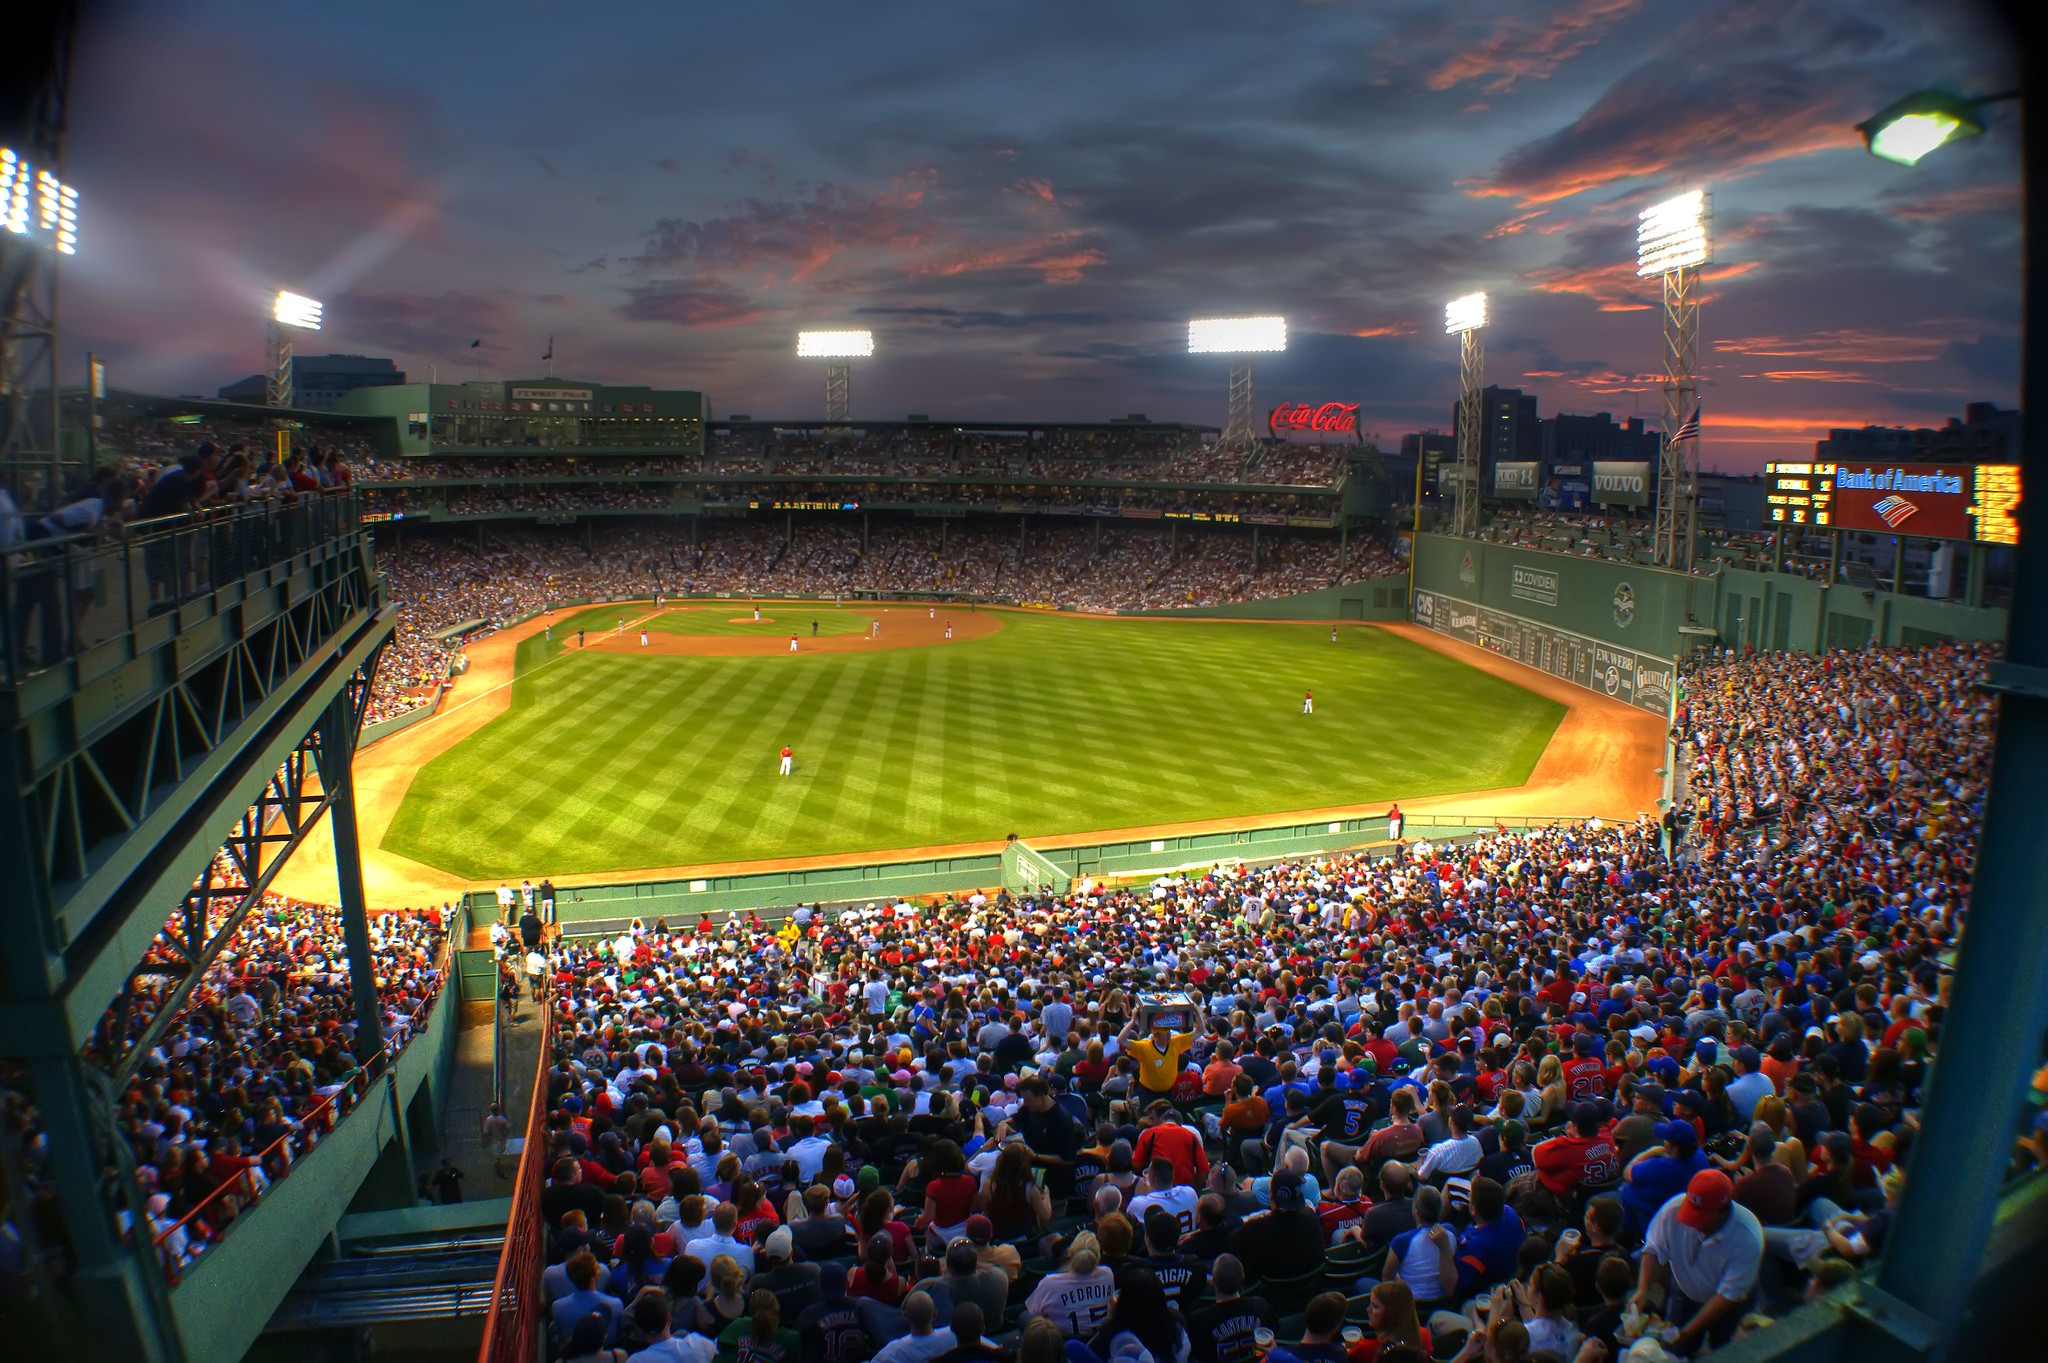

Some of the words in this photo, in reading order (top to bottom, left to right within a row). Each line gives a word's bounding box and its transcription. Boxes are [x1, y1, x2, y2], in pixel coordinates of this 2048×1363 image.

[1594, 475, 1644, 493] VOLVO
[1837, 467, 1874, 489] Bank
[1875, 468, 1893, 490] of
[1893, 469, 1963, 494] America
[1523, 573, 1556, 590] COVIDIEN
[1417, 593, 1433, 615] CVS
[1344, 1111, 1361, 1137] 5
[1154, 1268, 1192, 1285] RIGHT
[1060, 1285, 1113, 1306] PEDROIA
